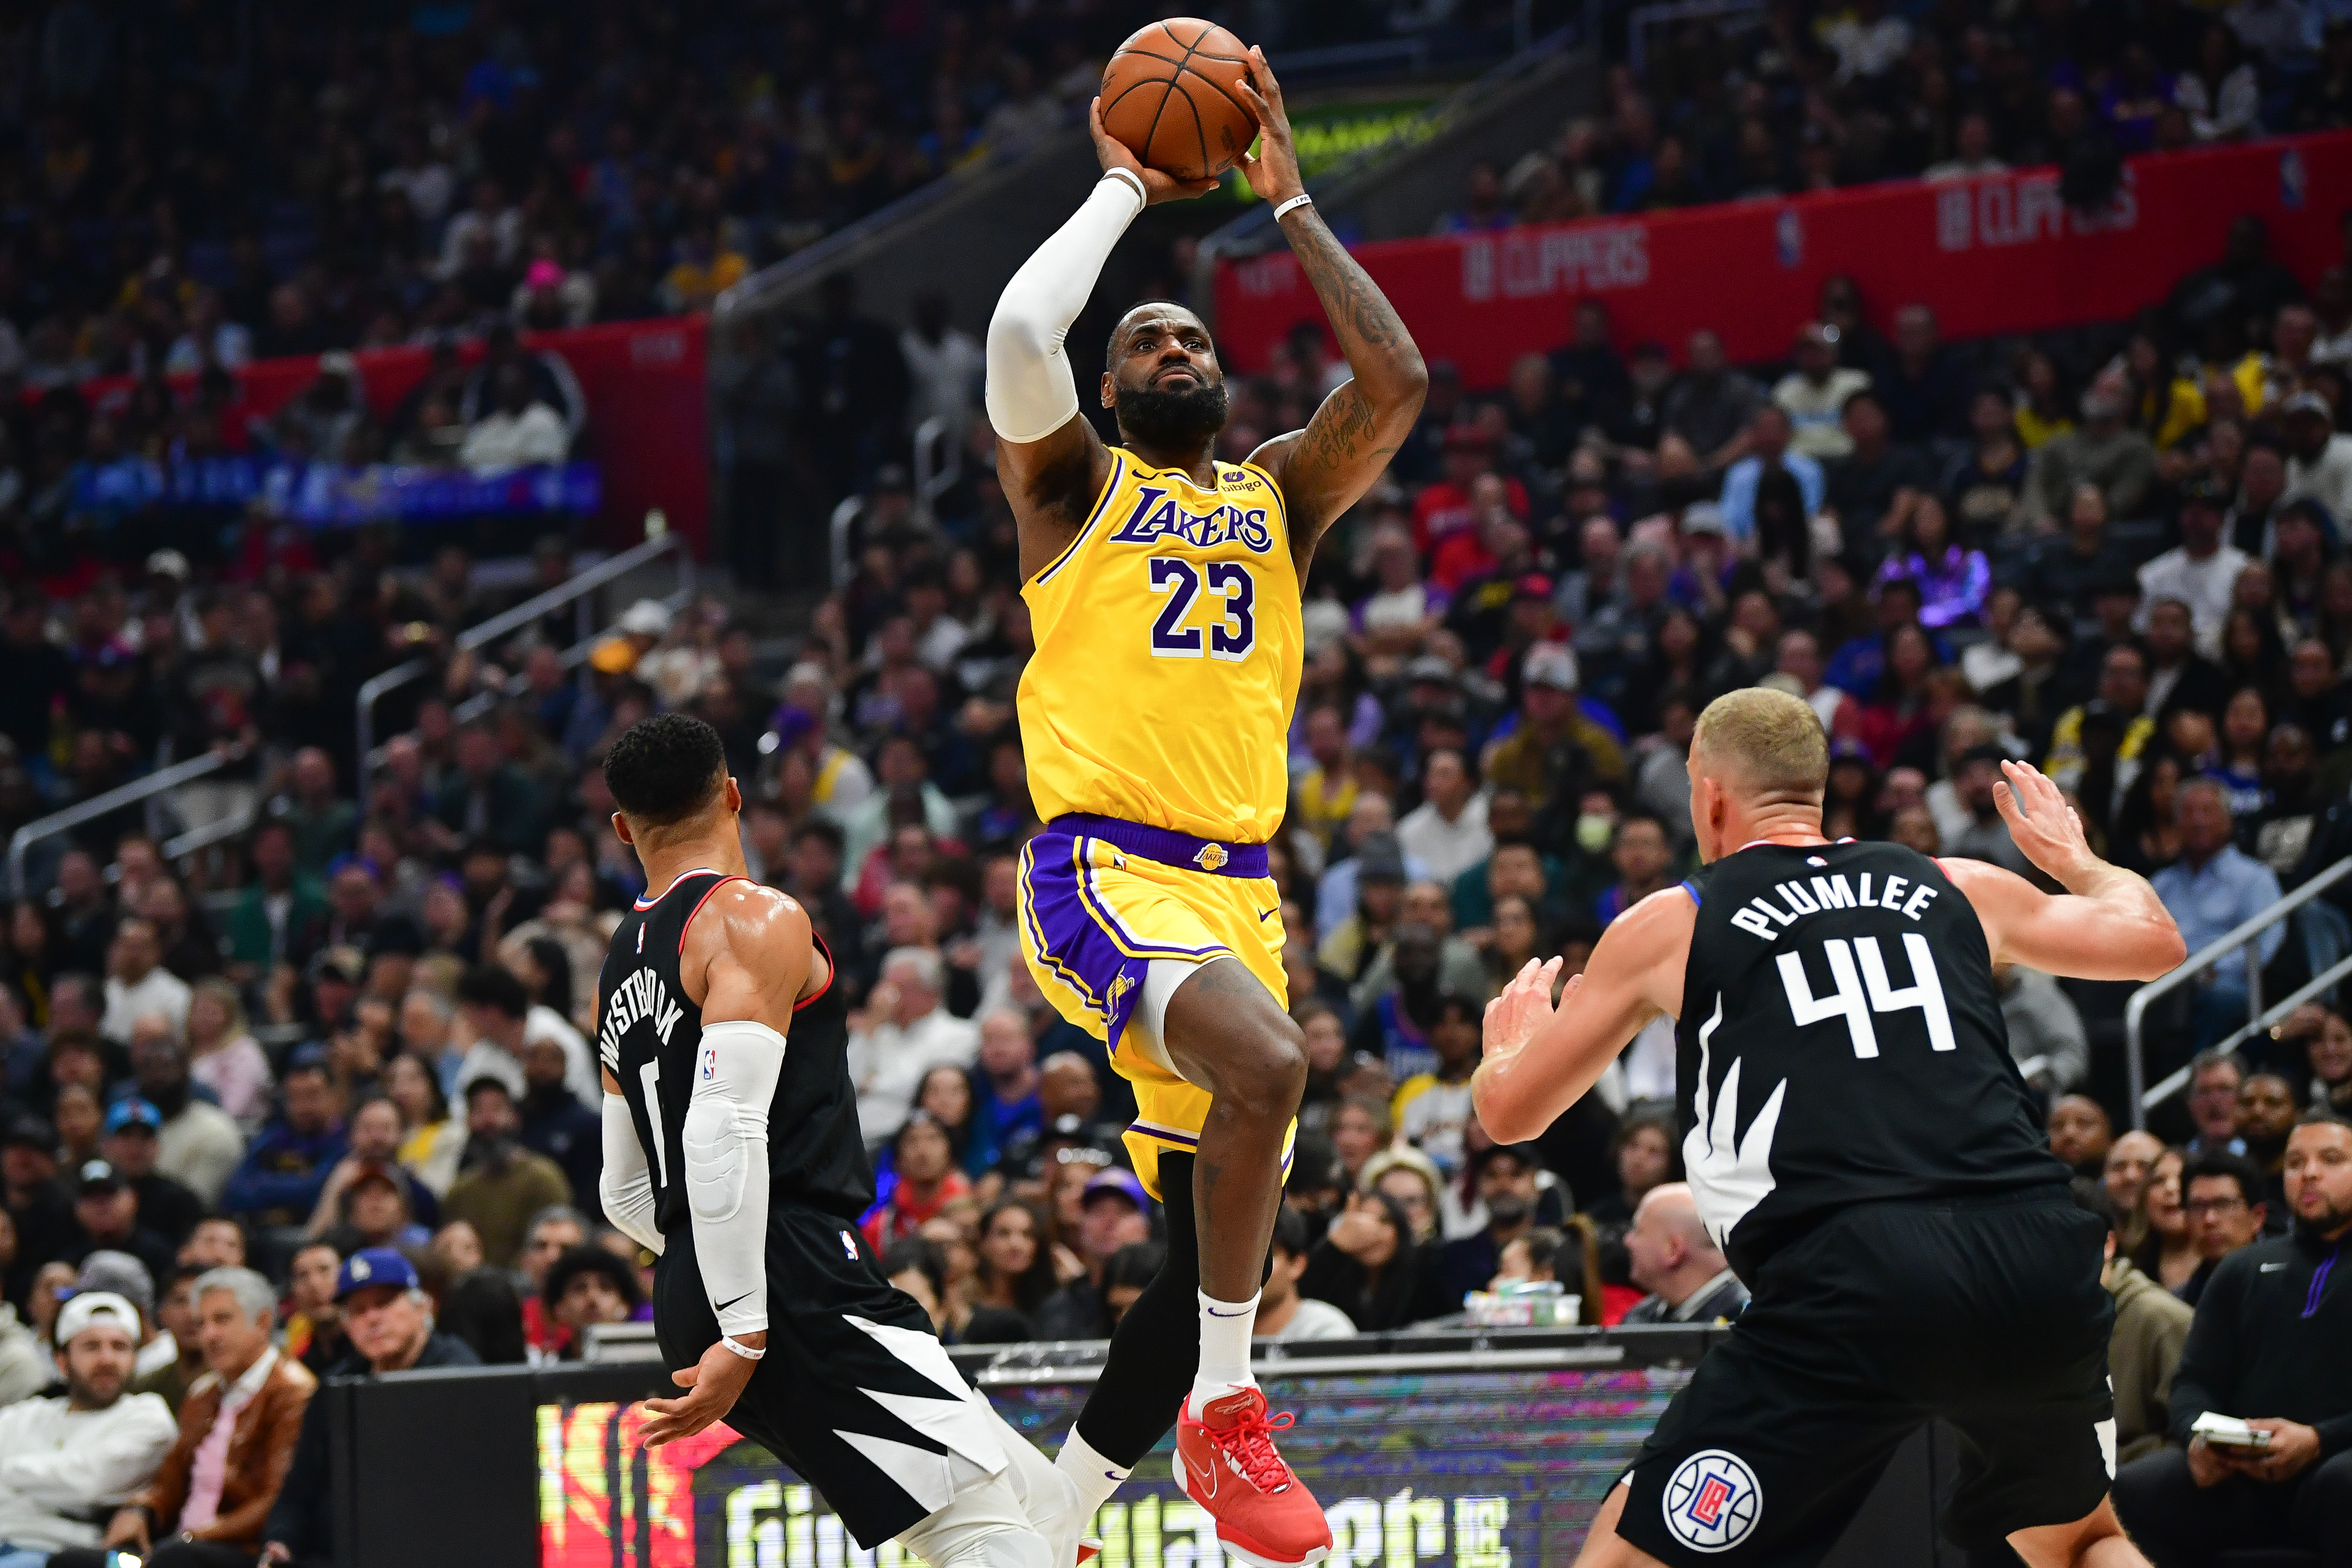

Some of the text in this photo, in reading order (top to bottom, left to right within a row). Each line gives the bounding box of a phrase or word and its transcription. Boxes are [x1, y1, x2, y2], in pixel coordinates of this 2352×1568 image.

[1107, 485, 1274, 554] LAKERS
[1221, 481, 1262, 492] bibigo
[1148, 556, 1255, 662] 23
[1730, 872, 1938, 941] PLUMLEE
[600, 966, 684, 1074] WESTBOOK
[1775, 933, 1957, 1059] 44
